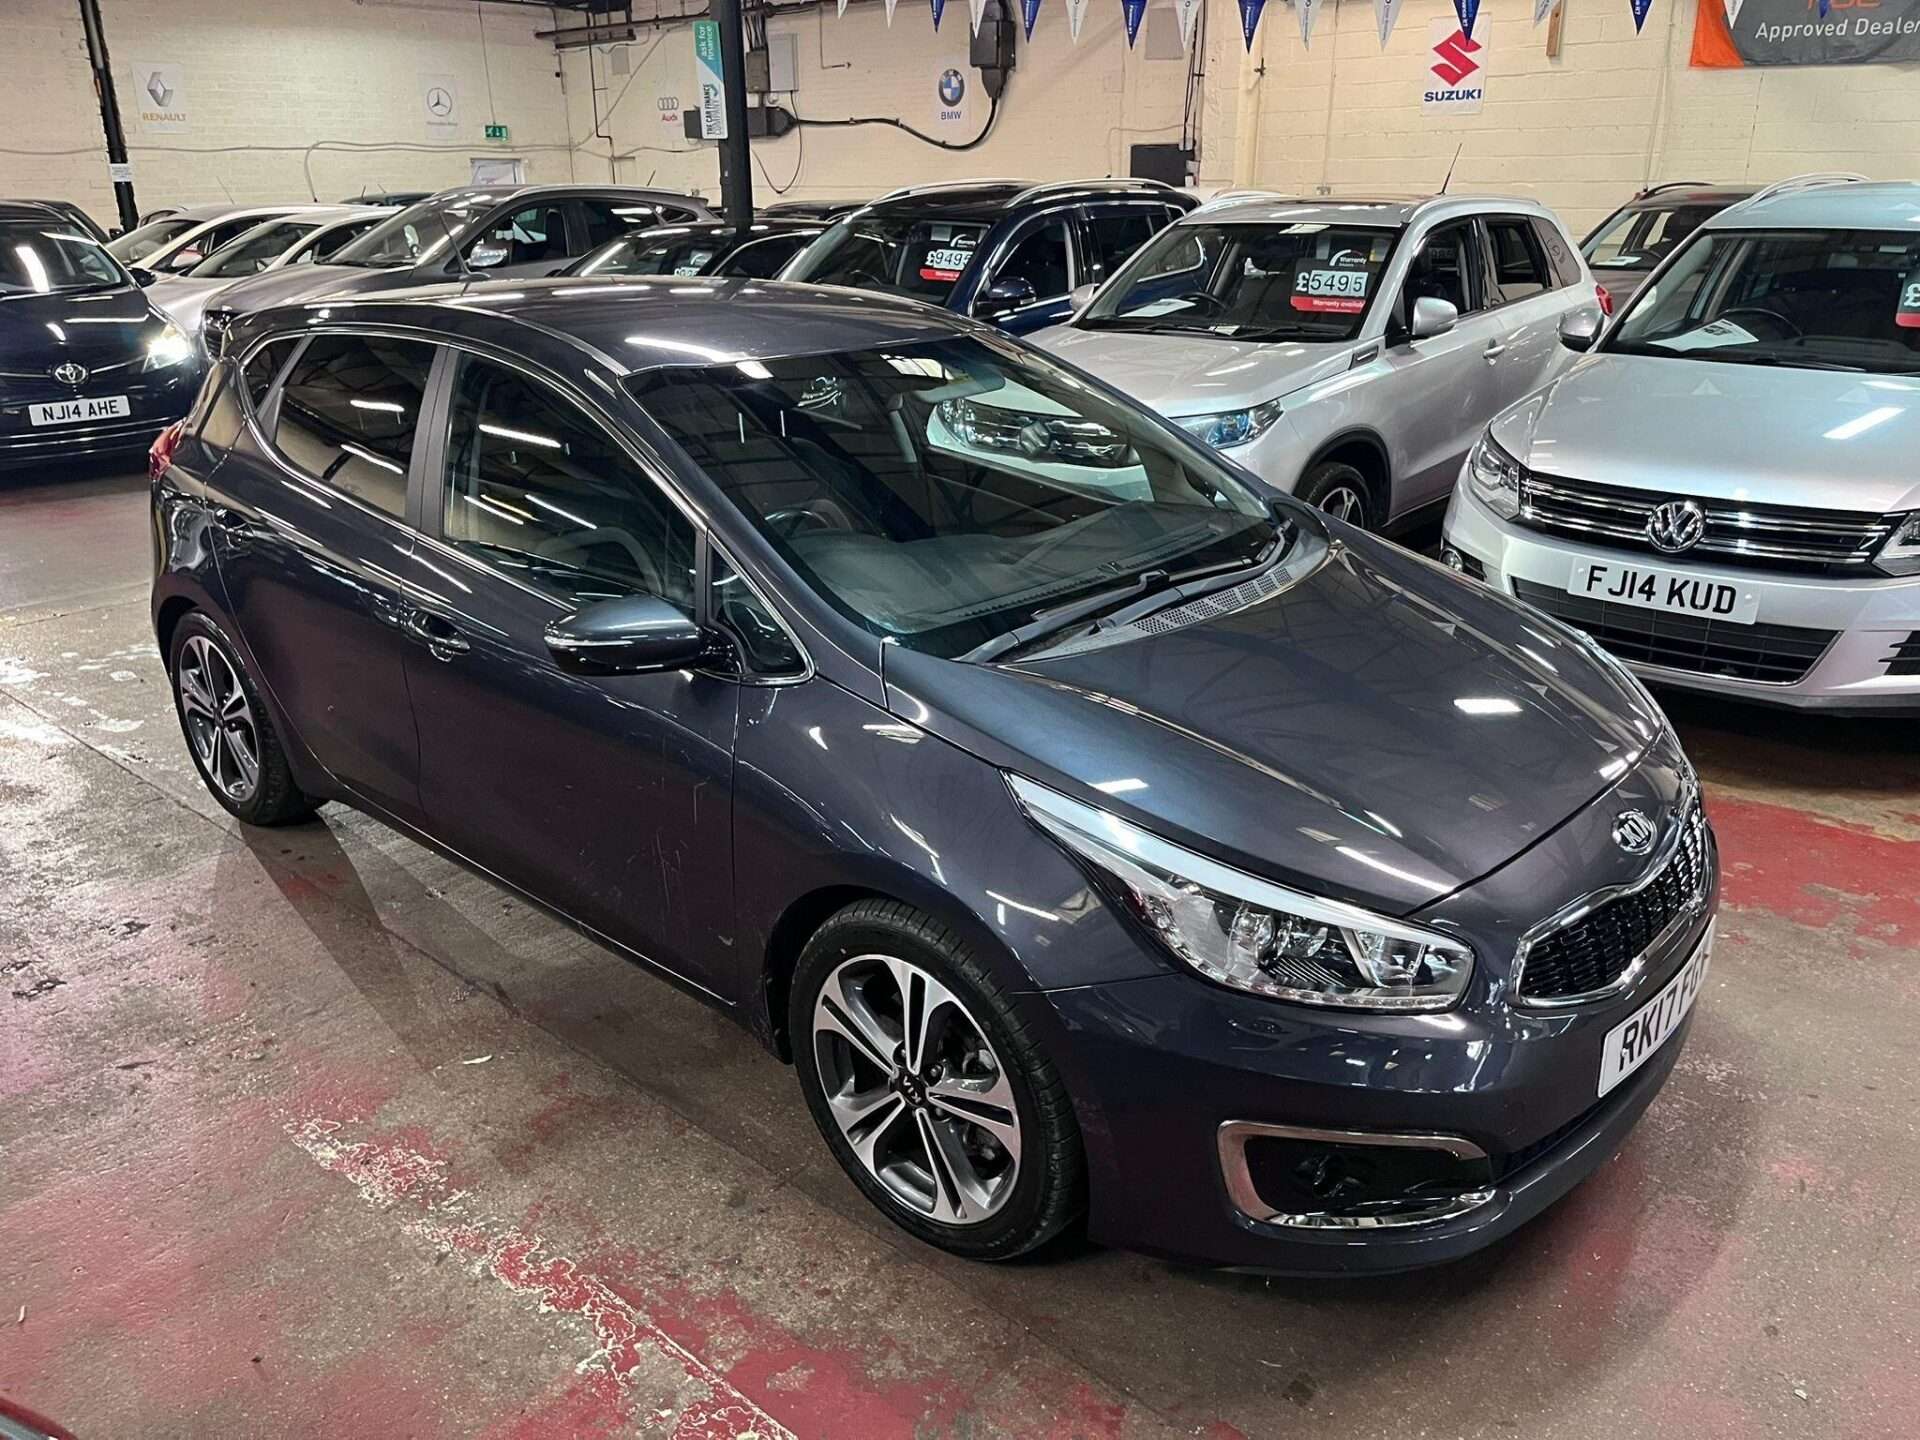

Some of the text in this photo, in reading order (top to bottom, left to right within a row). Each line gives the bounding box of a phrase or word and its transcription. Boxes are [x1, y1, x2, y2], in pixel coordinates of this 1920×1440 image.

[1755, 19, 1848, 42] Approved
[1424, 88, 1482, 102] SUZUKI
[142, 112, 186, 121] RENAULT
[941, 112, 962, 121] BMW
[1296, 271, 1363, 292] £5495
[42, 399, 120, 422] NJ14 AHE
[1586, 564, 1737, 615] FJ14 KUD
